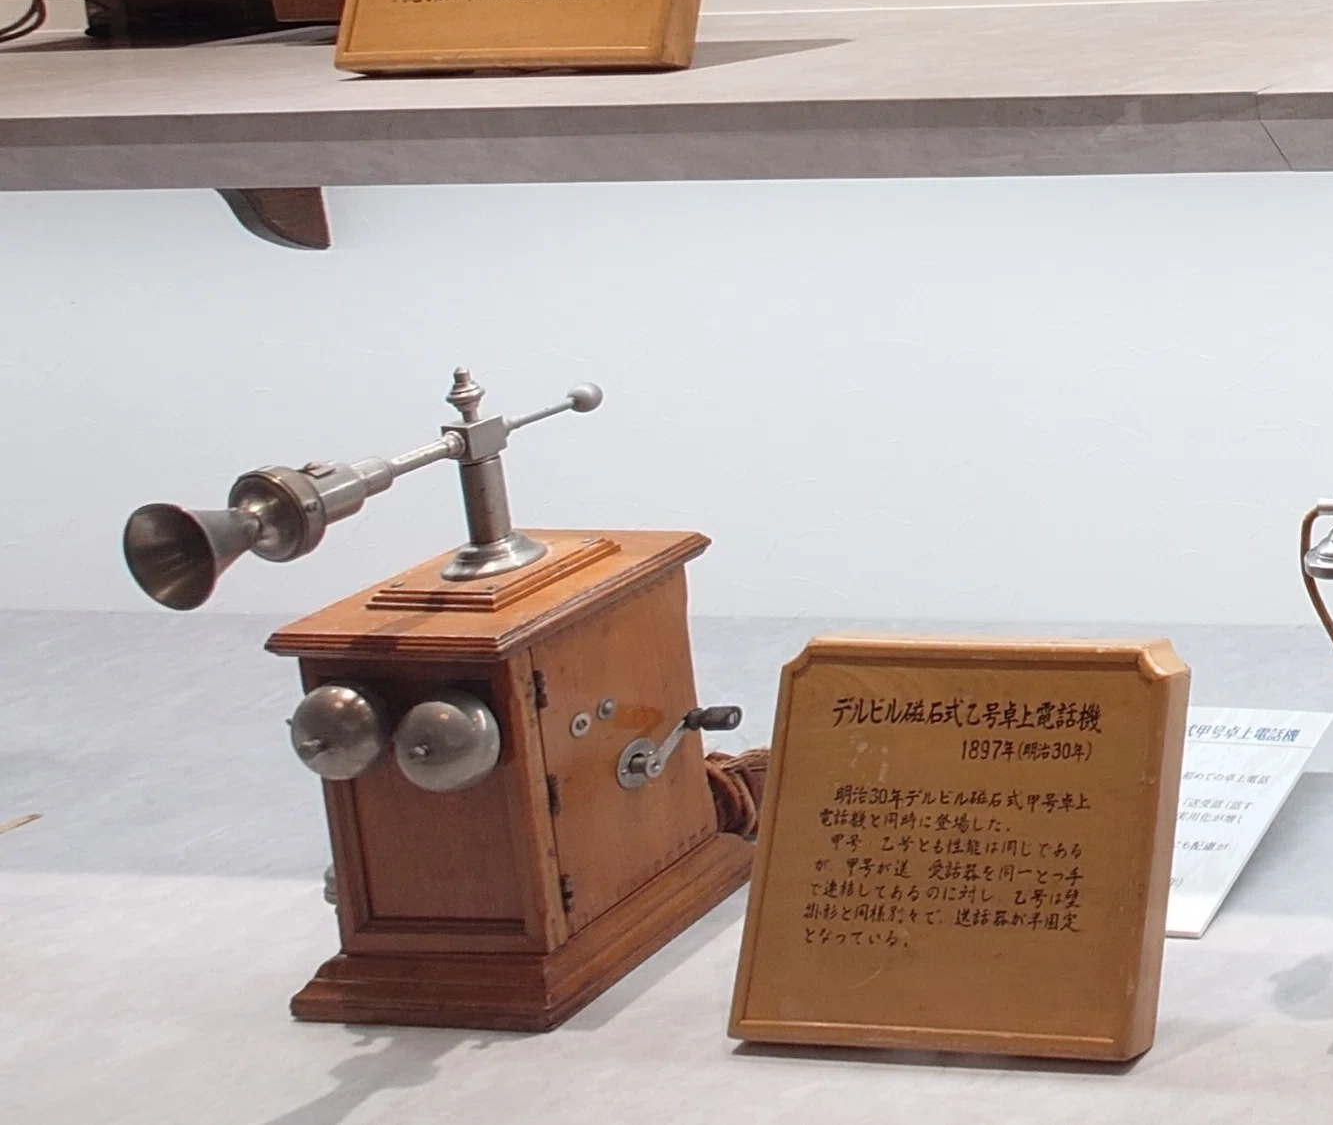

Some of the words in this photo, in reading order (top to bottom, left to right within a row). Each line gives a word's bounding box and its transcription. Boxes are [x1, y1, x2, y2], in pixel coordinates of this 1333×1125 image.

[832, 697, 1102, 734] デルビル磁石式乙号卓上電話機
[960, 739, 1093, 762] 1897年(明治30年)
